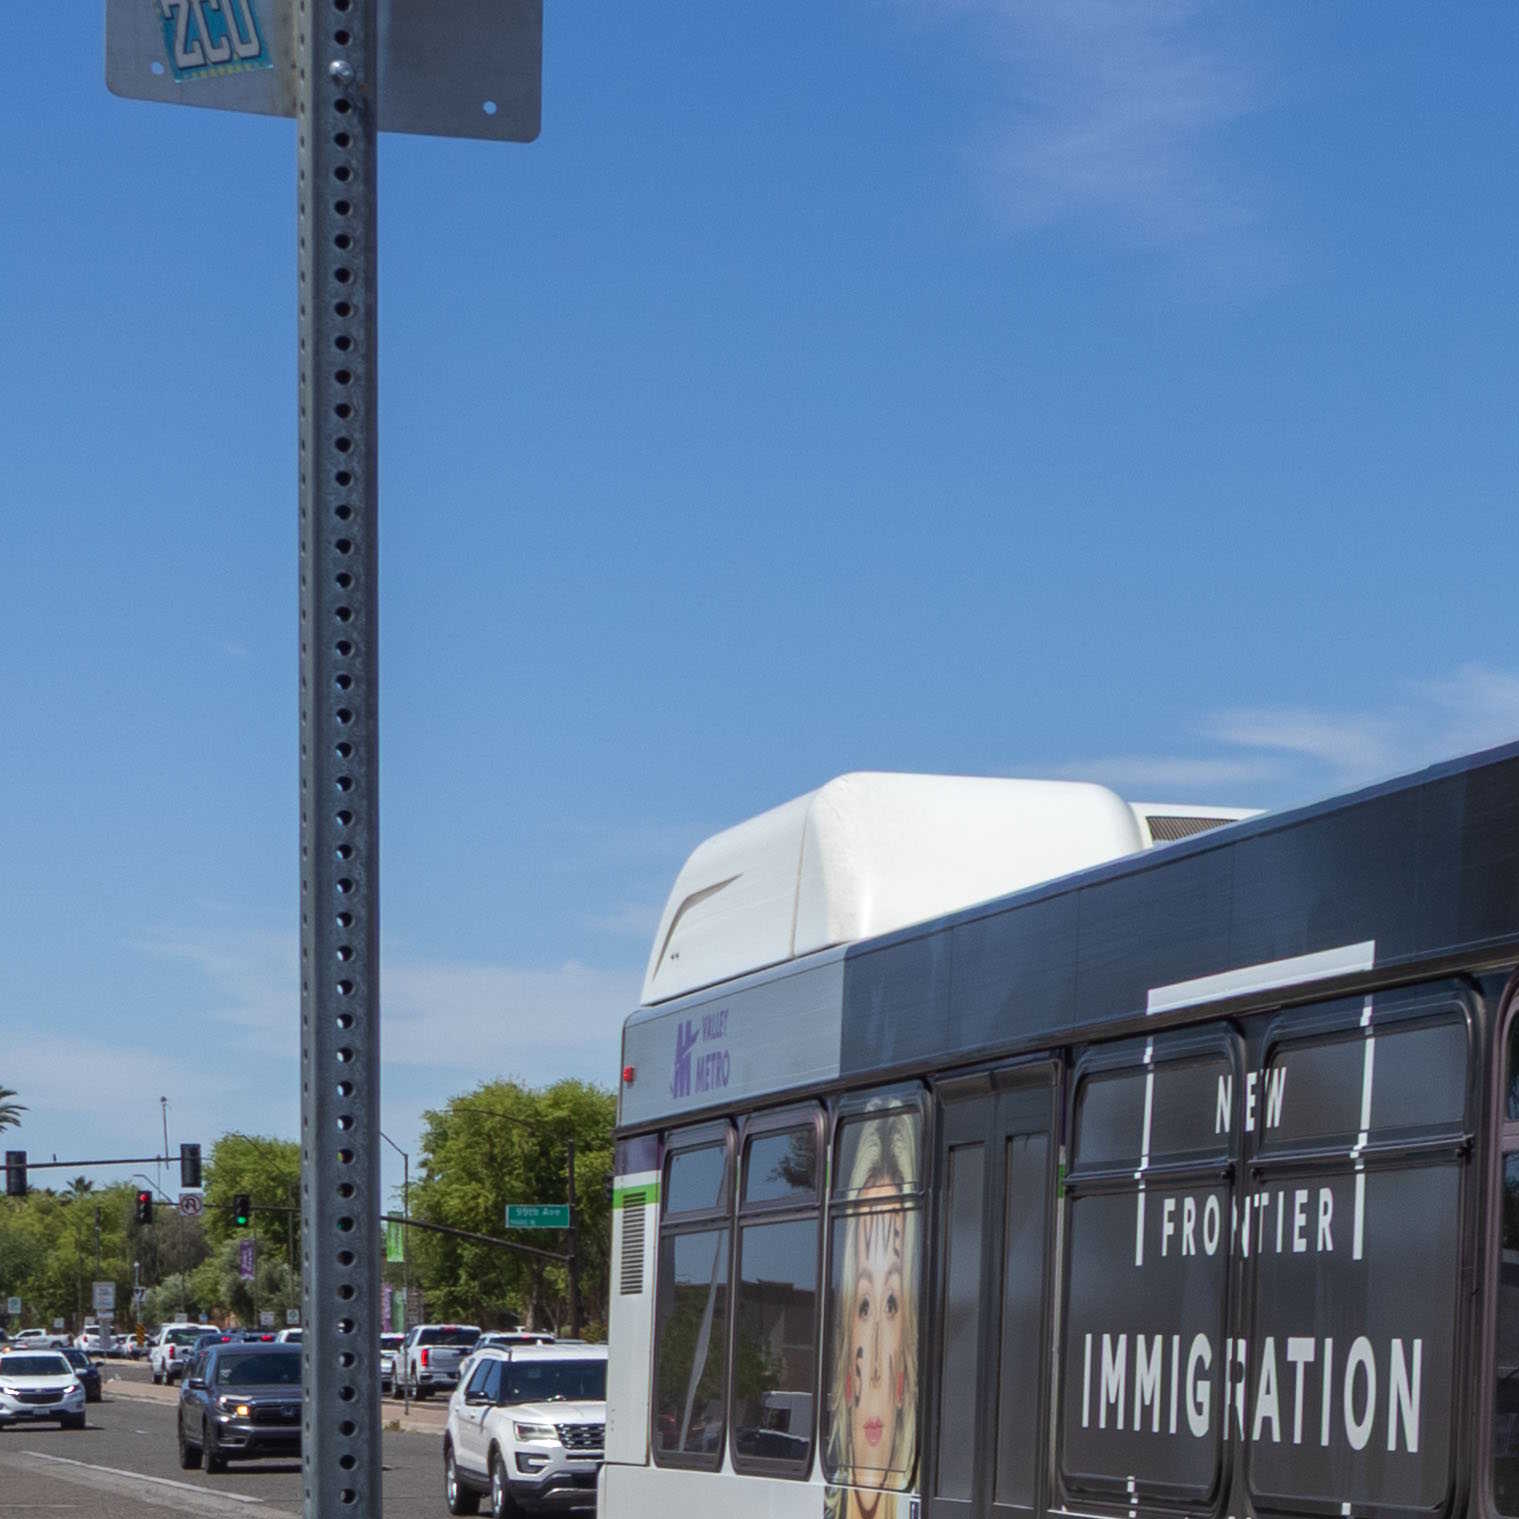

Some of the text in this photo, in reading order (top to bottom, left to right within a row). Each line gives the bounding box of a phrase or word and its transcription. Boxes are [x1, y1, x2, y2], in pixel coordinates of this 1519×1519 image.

[702, 1008, 729, 1041] VALLEY
[695, 1050, 731, 1094] METRO
[1215, 1066, 1288, 1134] NEW
[1160, 1187, 1334, 1258] FRONTIER
[1081, 1332, 1423, 1453] IMMIGRATION
